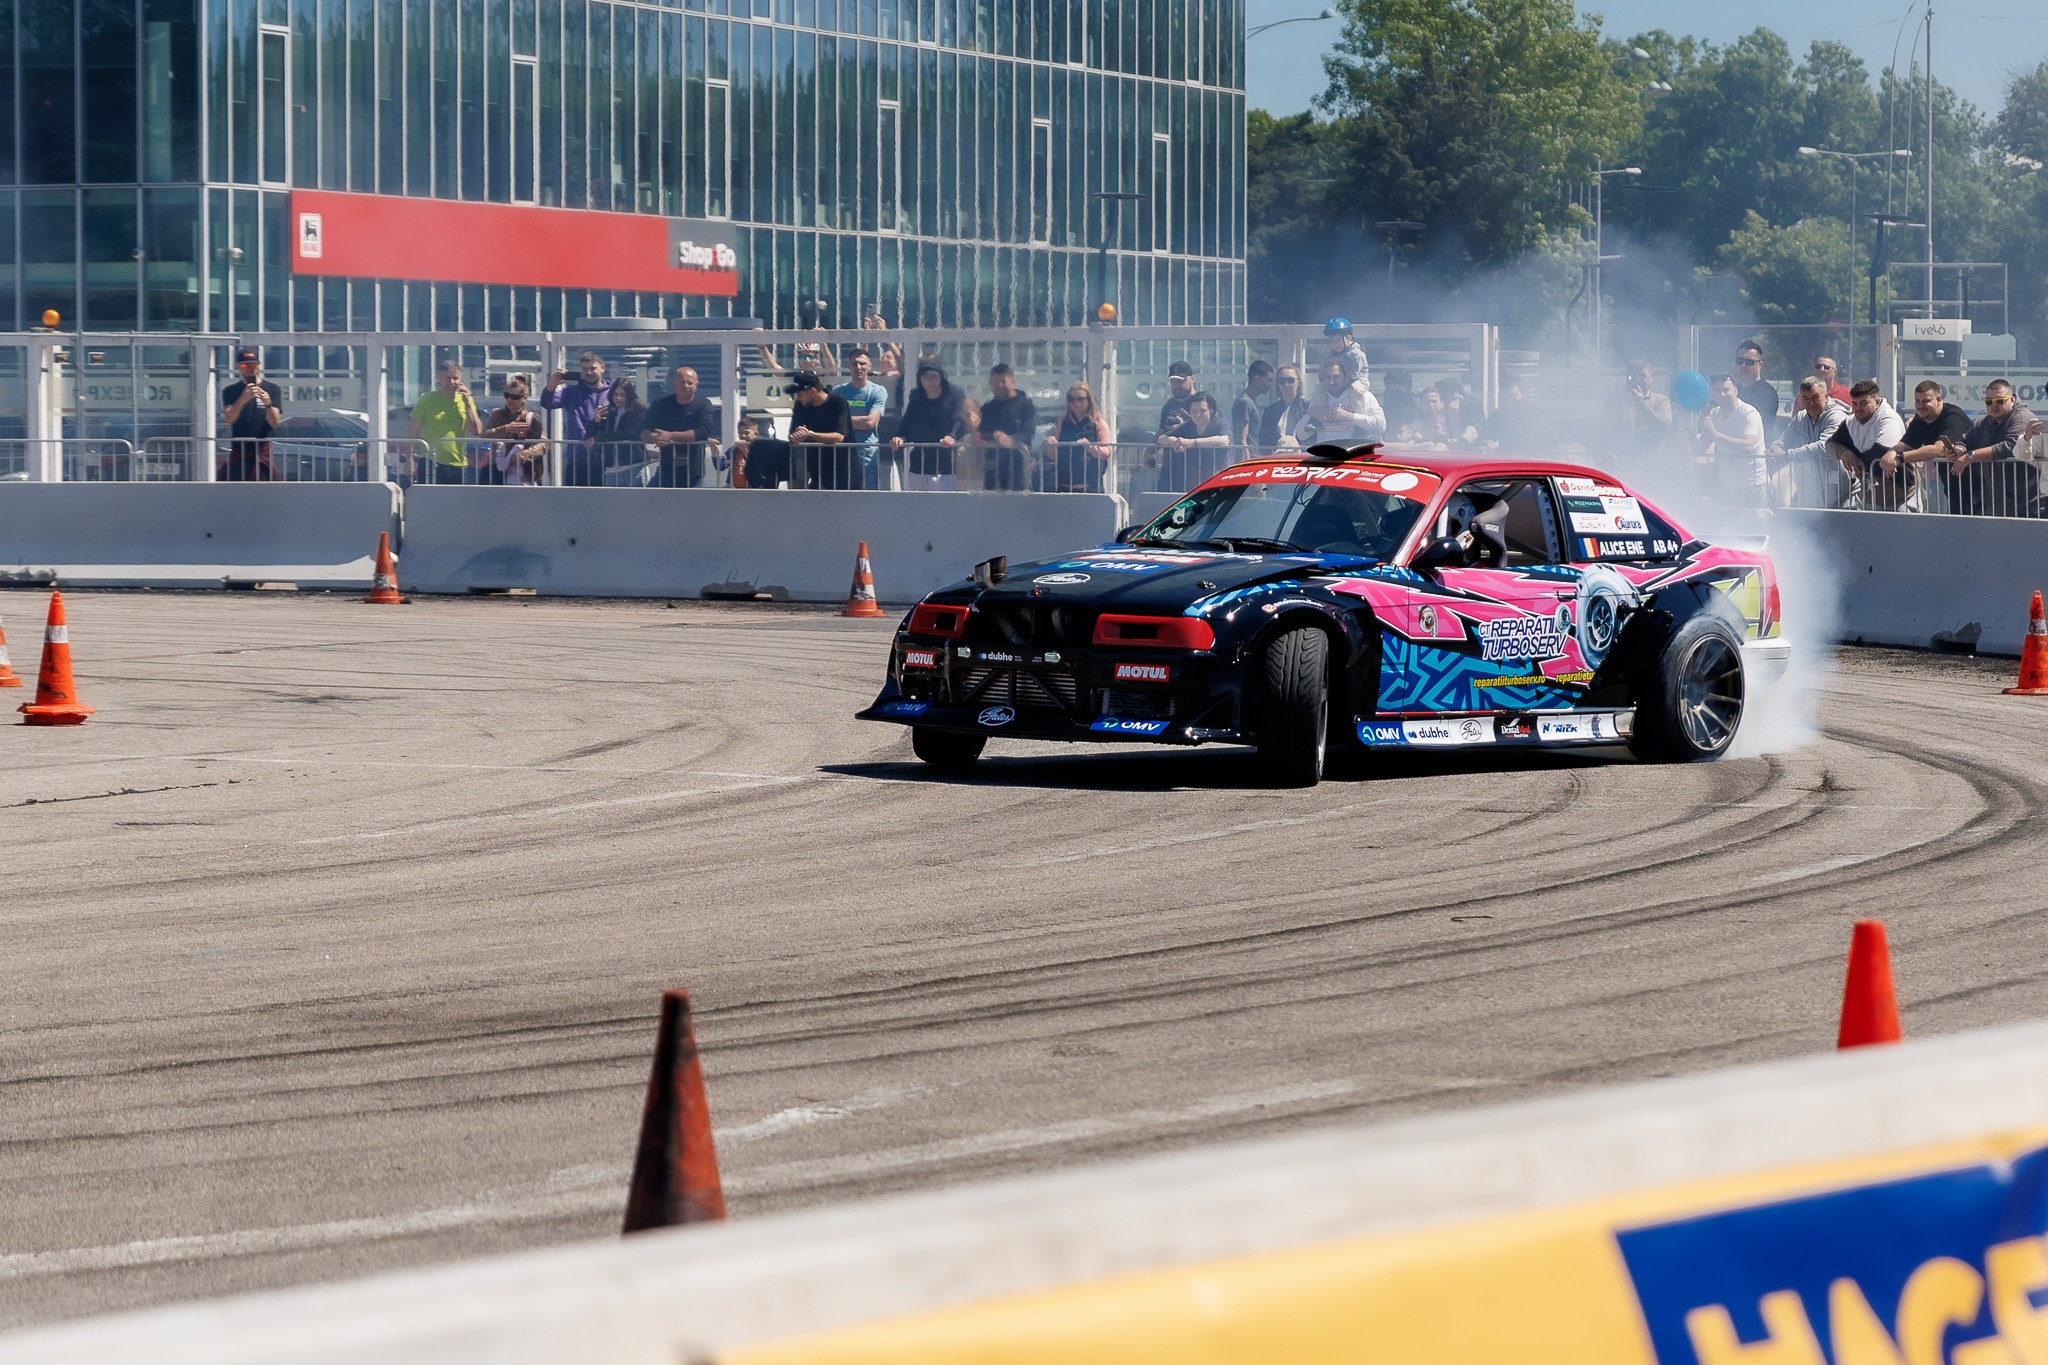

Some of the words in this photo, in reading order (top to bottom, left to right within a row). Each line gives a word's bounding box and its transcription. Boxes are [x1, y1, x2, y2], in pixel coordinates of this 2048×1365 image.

[1599, 541, 1626, 555] ALICE
[1625, 541, 1645, 555] ENE
[1653, 540, 1667, 554] AB
[1089, 561, 1160, 571] OMV
[1480, 624, 1491, 636] CT
[1483, 634, 1566, 659] TURBOSERV
[906, 652, 934, 665] MOTUL
[988, 652, 1013, 661] dubhe
[1117, 665, 1167, 680] MOTUL
[1473, 675, 1546, 688] reparatiiturboserv.ro
[896, 703, 926, 711] OMV
[1121, 722, 1160, 731] OMV
[1420, 726, 1449, 739] dubhe
[1375, 727, 1400, 740] OMV
